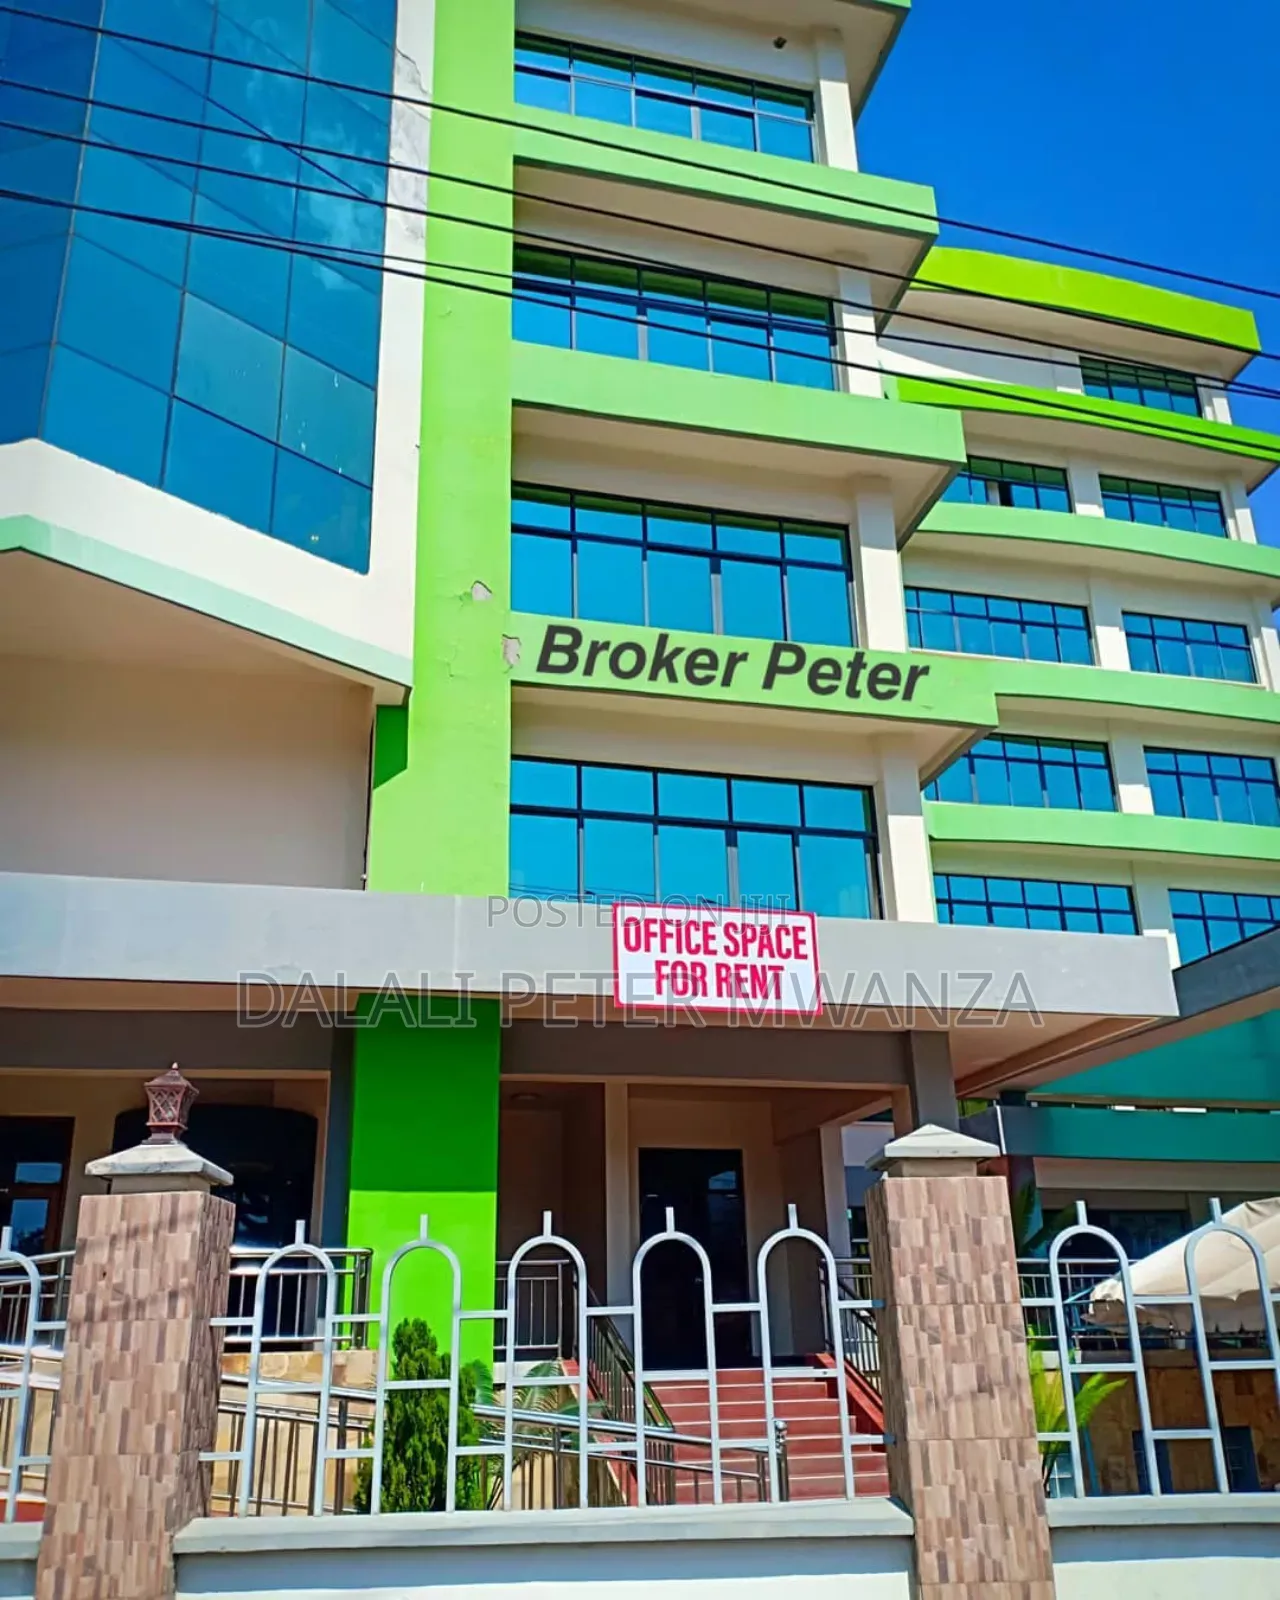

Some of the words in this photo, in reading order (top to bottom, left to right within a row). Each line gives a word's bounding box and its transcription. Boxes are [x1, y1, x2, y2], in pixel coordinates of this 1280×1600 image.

[623, 916, 718, 956] OFFICE
[723, 921, 808, 960] SPACE
[654, 960, 708, 997] FOR
[715, 963, 784, 1000] RENT
